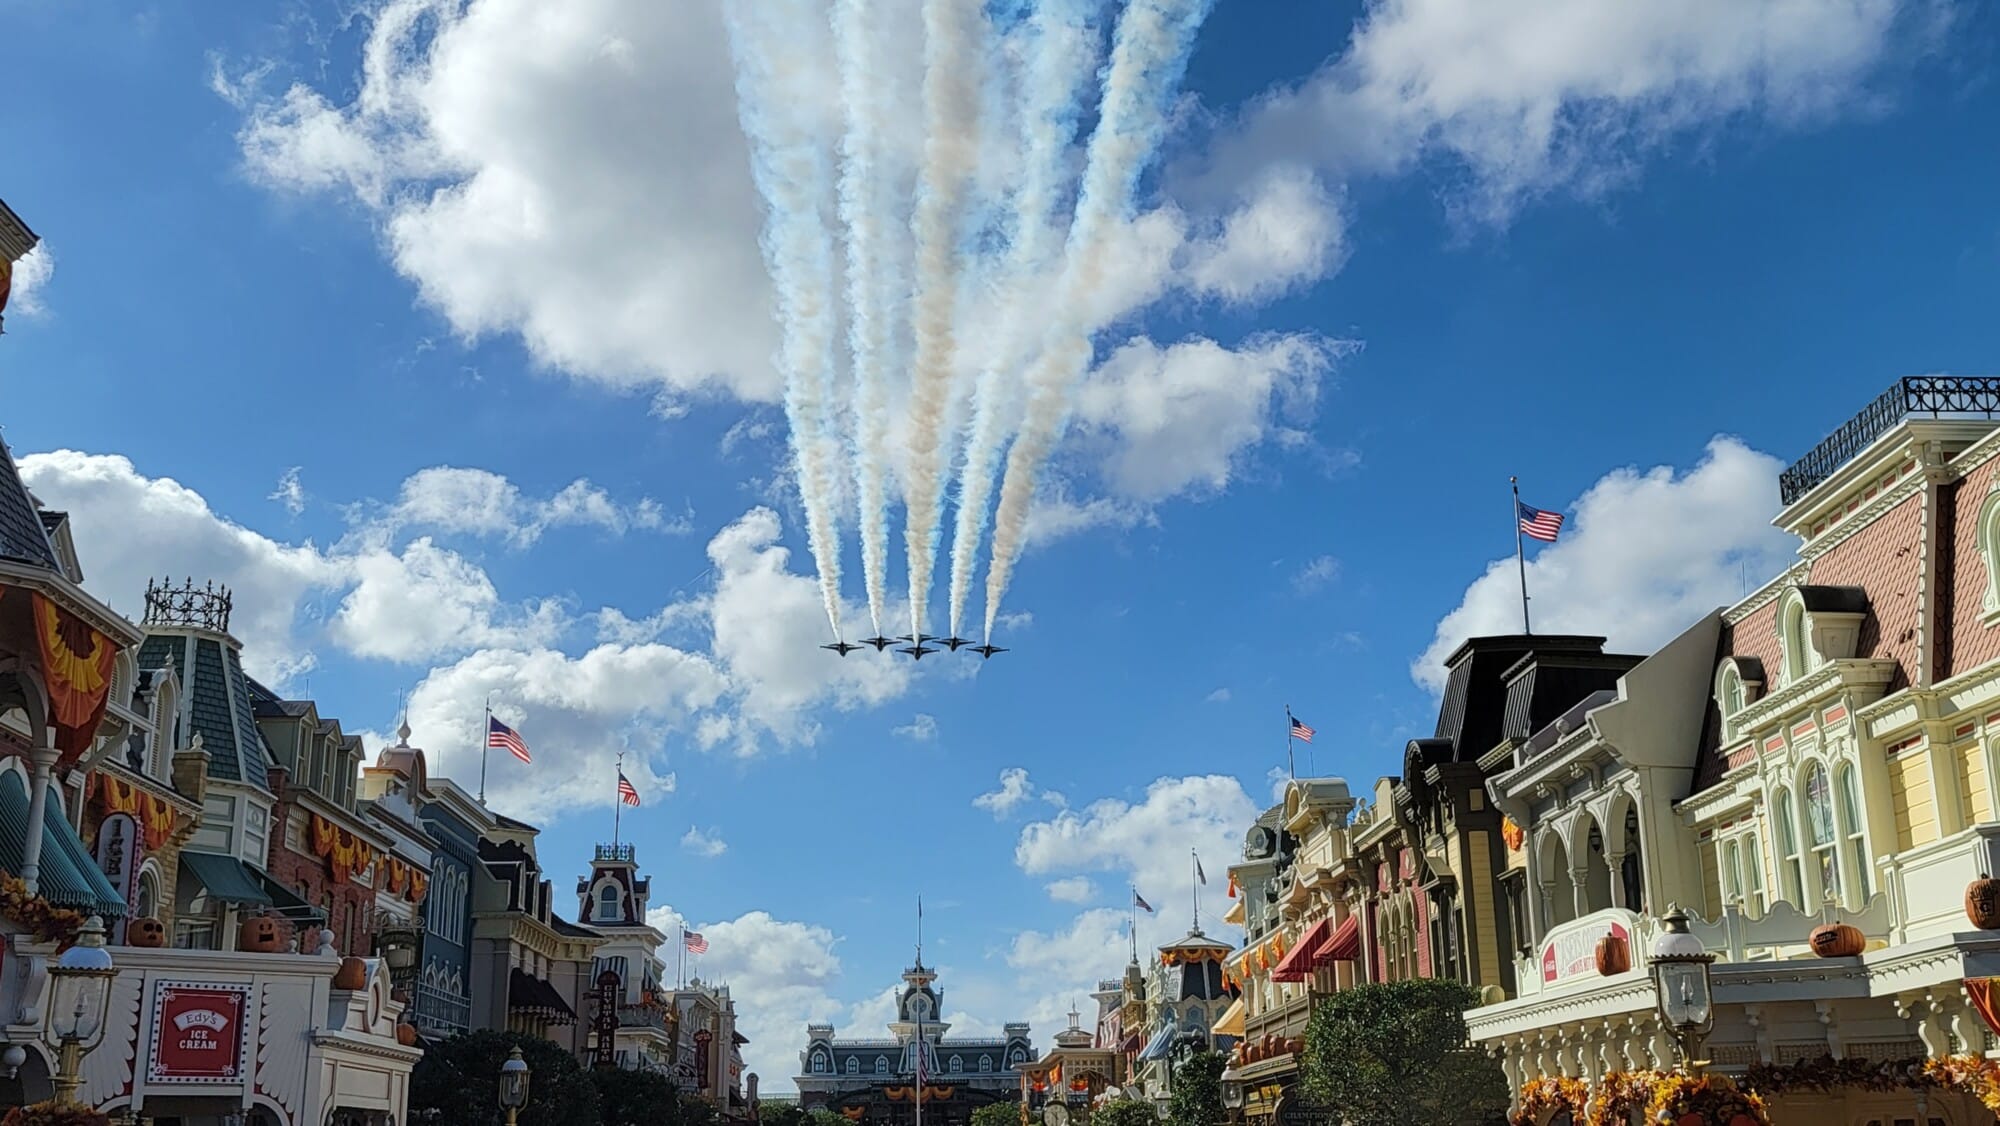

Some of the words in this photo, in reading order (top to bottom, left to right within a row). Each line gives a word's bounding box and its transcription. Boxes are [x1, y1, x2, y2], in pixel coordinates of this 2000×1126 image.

[603, 984, 612, 1030] CRYSTAL
[186, 1011, 217, 1025] Edy's
[191, 1030, 208, 1040] ICE
[179, 1040, 217, 1050] CREAM
[601, 1035, 610, 1062] ARTS
